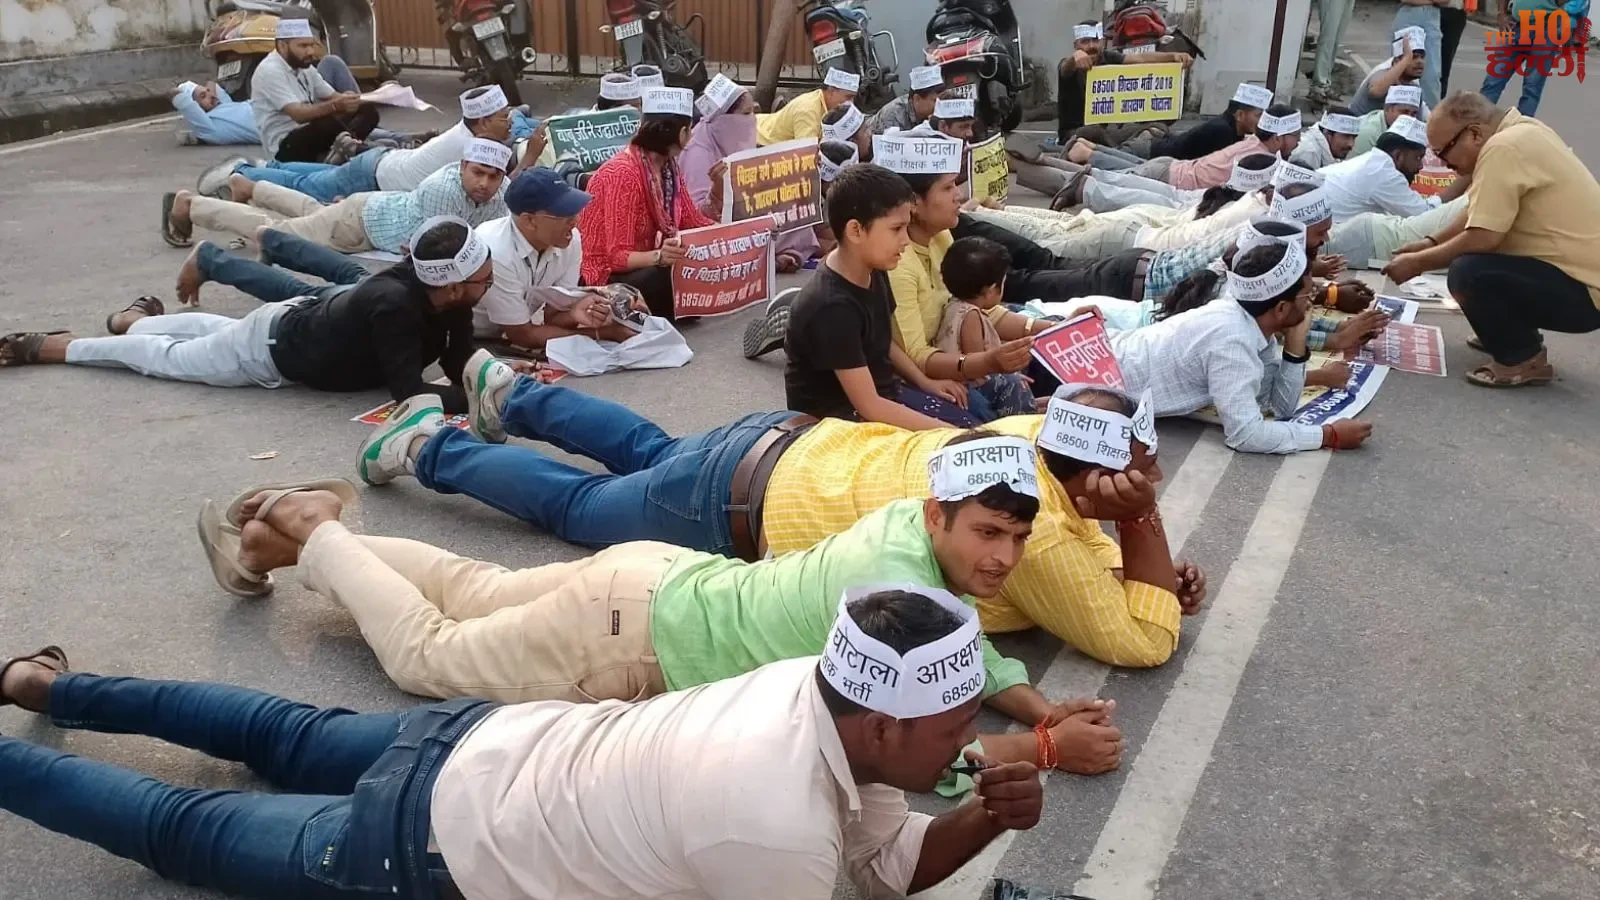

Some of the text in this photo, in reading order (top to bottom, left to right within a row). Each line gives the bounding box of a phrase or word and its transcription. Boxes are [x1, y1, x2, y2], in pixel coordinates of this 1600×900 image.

[1092, 79, 1115, 93] 68500
[1117, 75, 1139, 92] शिक्षक
[1154, 76, 1173, 90] 2018
[649, 90, 682, 101] आरक्षण
[914, 138, 957, 156] घोटाला
[900, 158, 926, 170] शिक्षक
[1292, 199, 1327, 219] आरक्षण
[681, 266, 696, 279] पर
[681, 291, 713, 308] 68500
[1052, 407, 1111, 436] आरक्षण
[1056, 432, 1131, 461] 68500 शिक्षक
[953, 446, 1021, 467] आरक्षण
[968, 472, 1009, 486] 68500
[833, 626, 982, 688] घोटाला आरक्षण
[843, 677, 873, 702] भर्ती
[943, 673, 981, 705] 68500
